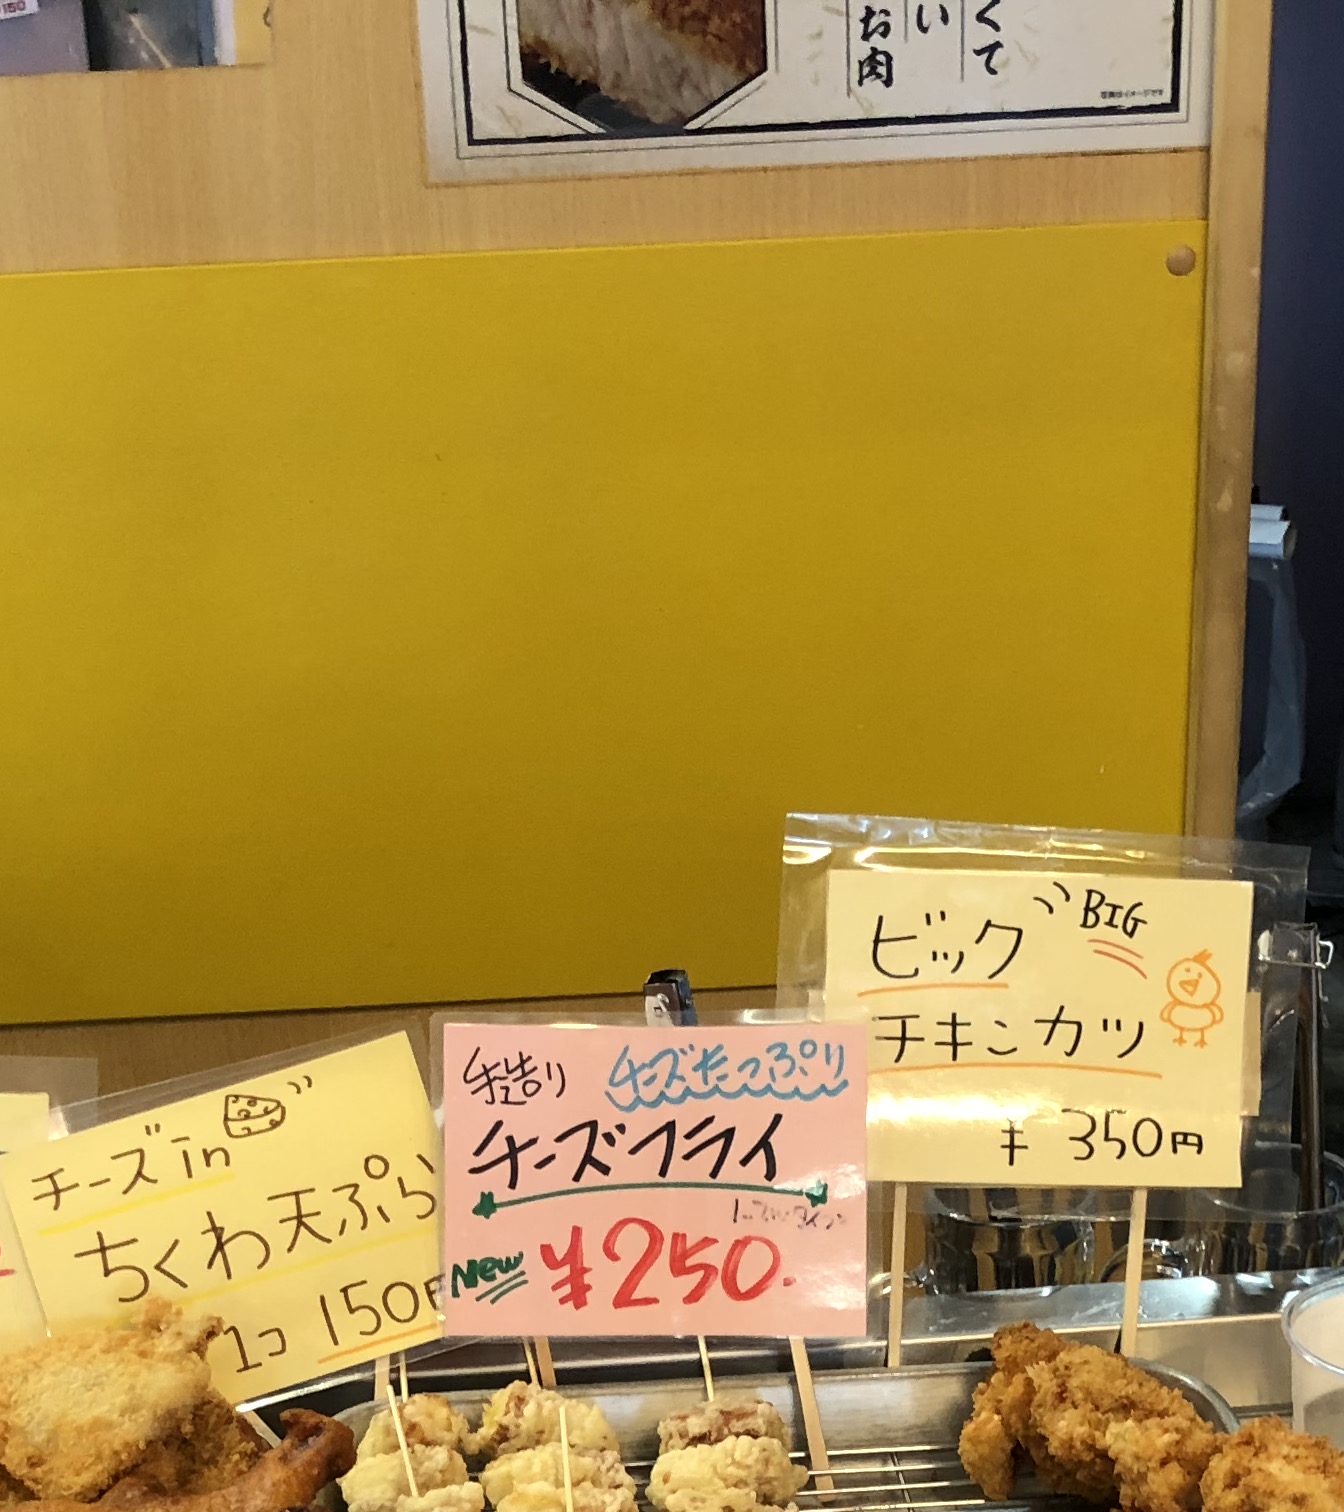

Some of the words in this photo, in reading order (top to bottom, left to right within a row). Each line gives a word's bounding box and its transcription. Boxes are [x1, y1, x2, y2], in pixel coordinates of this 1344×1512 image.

[857, 4, 895, 88] お肉
[871, 910, 1024, 980] ビック
[1079, 888, 1149, 939] BIG
[606, 1039, 848, 1090] チーズたっぷり
[871, 1005, 1144, 1064] チキンカツ
[468, 1112, 784, 1190] チーズフライ
[73, 1153, 440, 1304] ちくわ天ぷら
